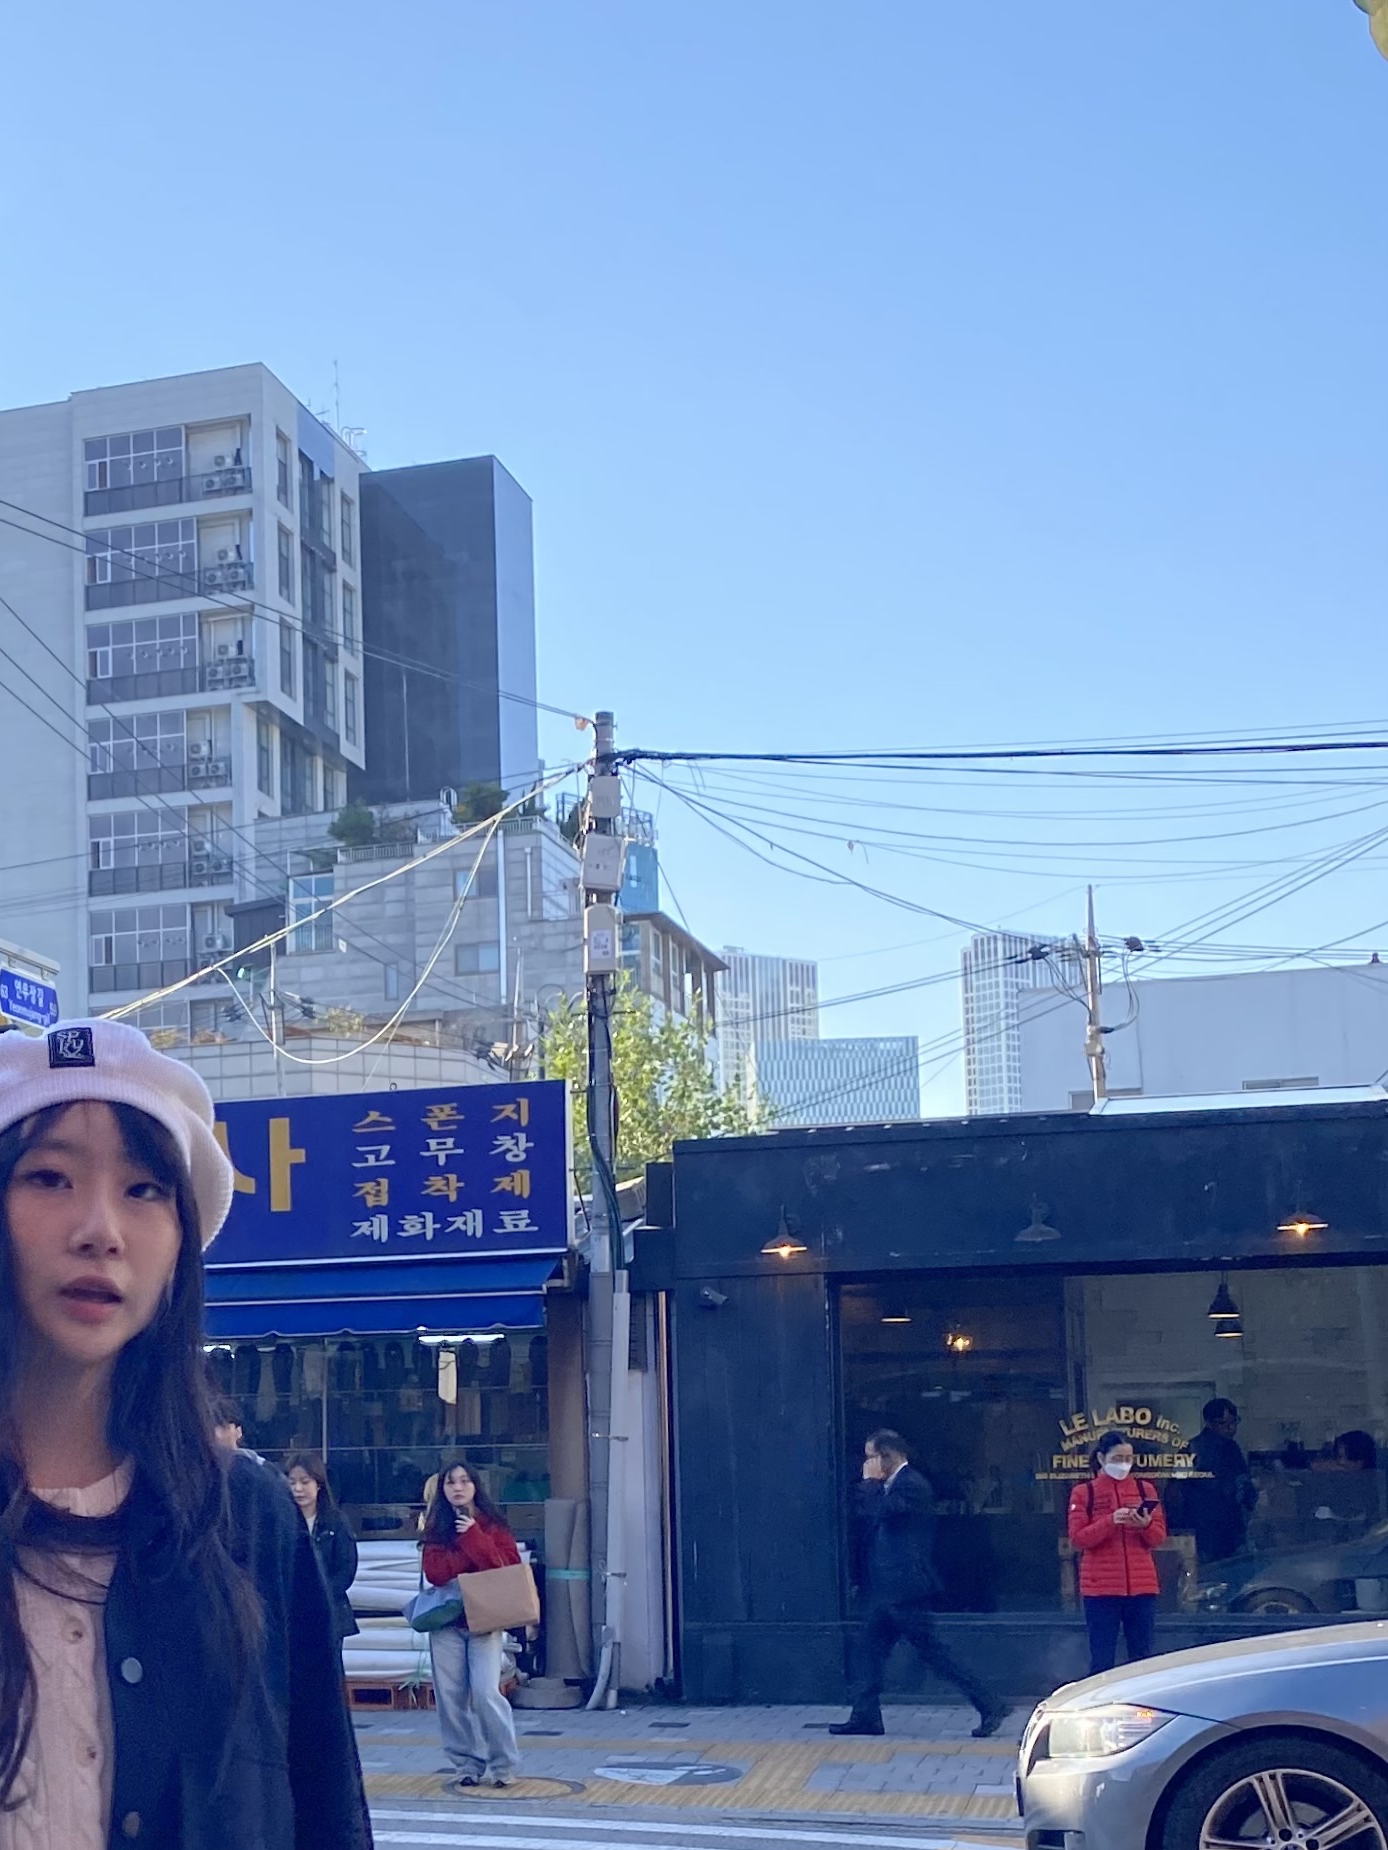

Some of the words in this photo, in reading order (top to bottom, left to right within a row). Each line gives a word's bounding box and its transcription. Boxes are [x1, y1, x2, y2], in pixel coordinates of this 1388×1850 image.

[350, 1209, 539, 1243] 제화재료
[1059, 1412, 1089, 1436] LE
[1091, 1406, 1152, 1427] LABO
[1171, 1437, 1190, 1450] OF
[1052, 1454, 1090, 1469] FINE
